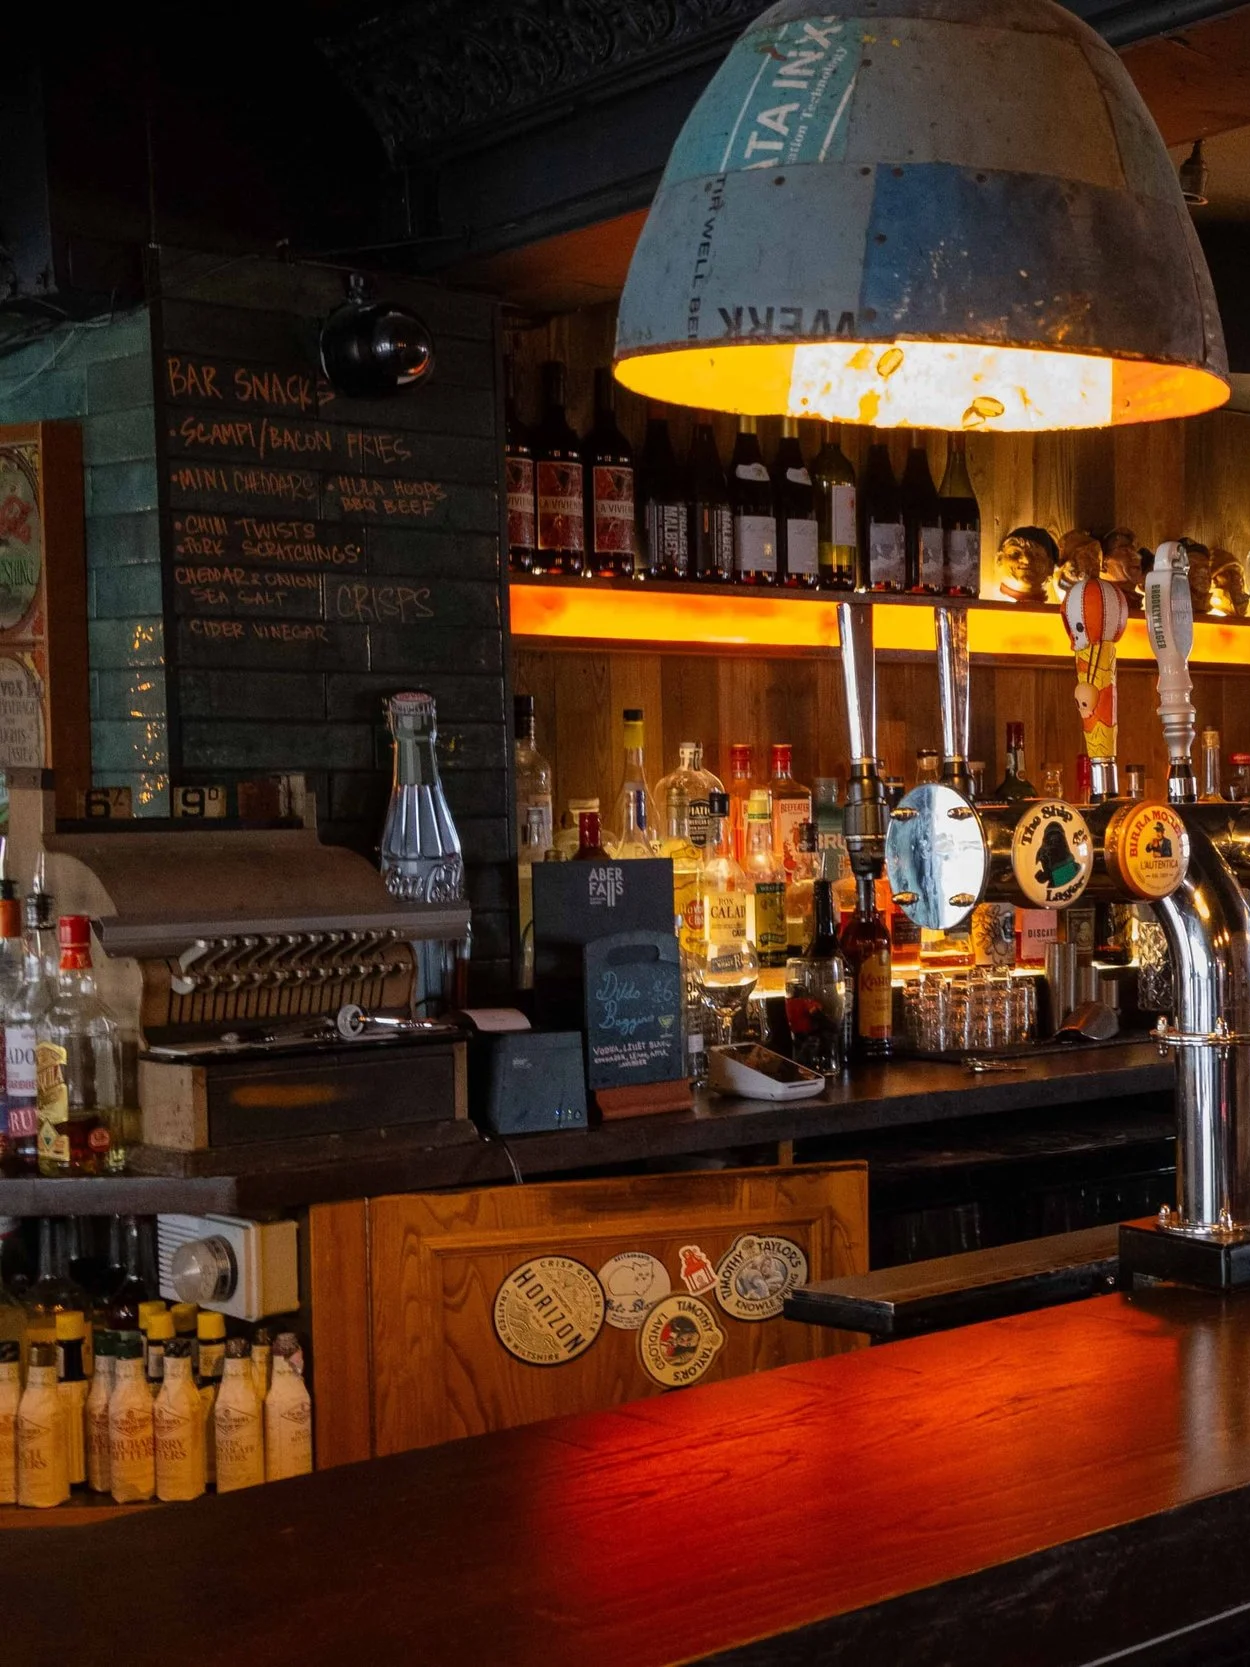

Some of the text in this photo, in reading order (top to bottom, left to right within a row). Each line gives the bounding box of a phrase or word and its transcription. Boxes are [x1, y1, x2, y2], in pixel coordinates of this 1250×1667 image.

[802, 46, 848, 119] Technology
[693, 217, 716, 289] WELL
[168, 357, 223, 400] BAR
[347, 433, 412, 463] FRIES
[178, 471, 228, 491] MINI
[338, 477, 385, 496] HULA
[385, 500, 435, 515] BEEF
[184, 536, 224, 557] PORK
[235, 519, 315, 539] TWISTS
[664, 505, 678, 556] MALBEC
[191, 588, 287, 606] SEA SALT
[265, 573, 321, 588] ONION
[336, 586, 434, 623] CRISPS
[1151, 584, 1167, 649] BROOKLYN LAGER
[190, 620, 329, 642] CIDER VINEGAR
[1021, 805, 1074, 846] The Ship
[1130, 814, 1151, 857] BIRRA
[589, 867, 624, 881] ABER
[540, 1260, 574, 1268] CRISP
[577, 1268, 600, 1308] GOLDEN
[721, 1250, 745, 1300] TIMOTHY
[513, 1267, 586, 1353] HORIZON
[649, 1312, 669, 1370] LANDLORD
[673, 1300, 714, 1382] TIMOTHY TAYLOR'S
